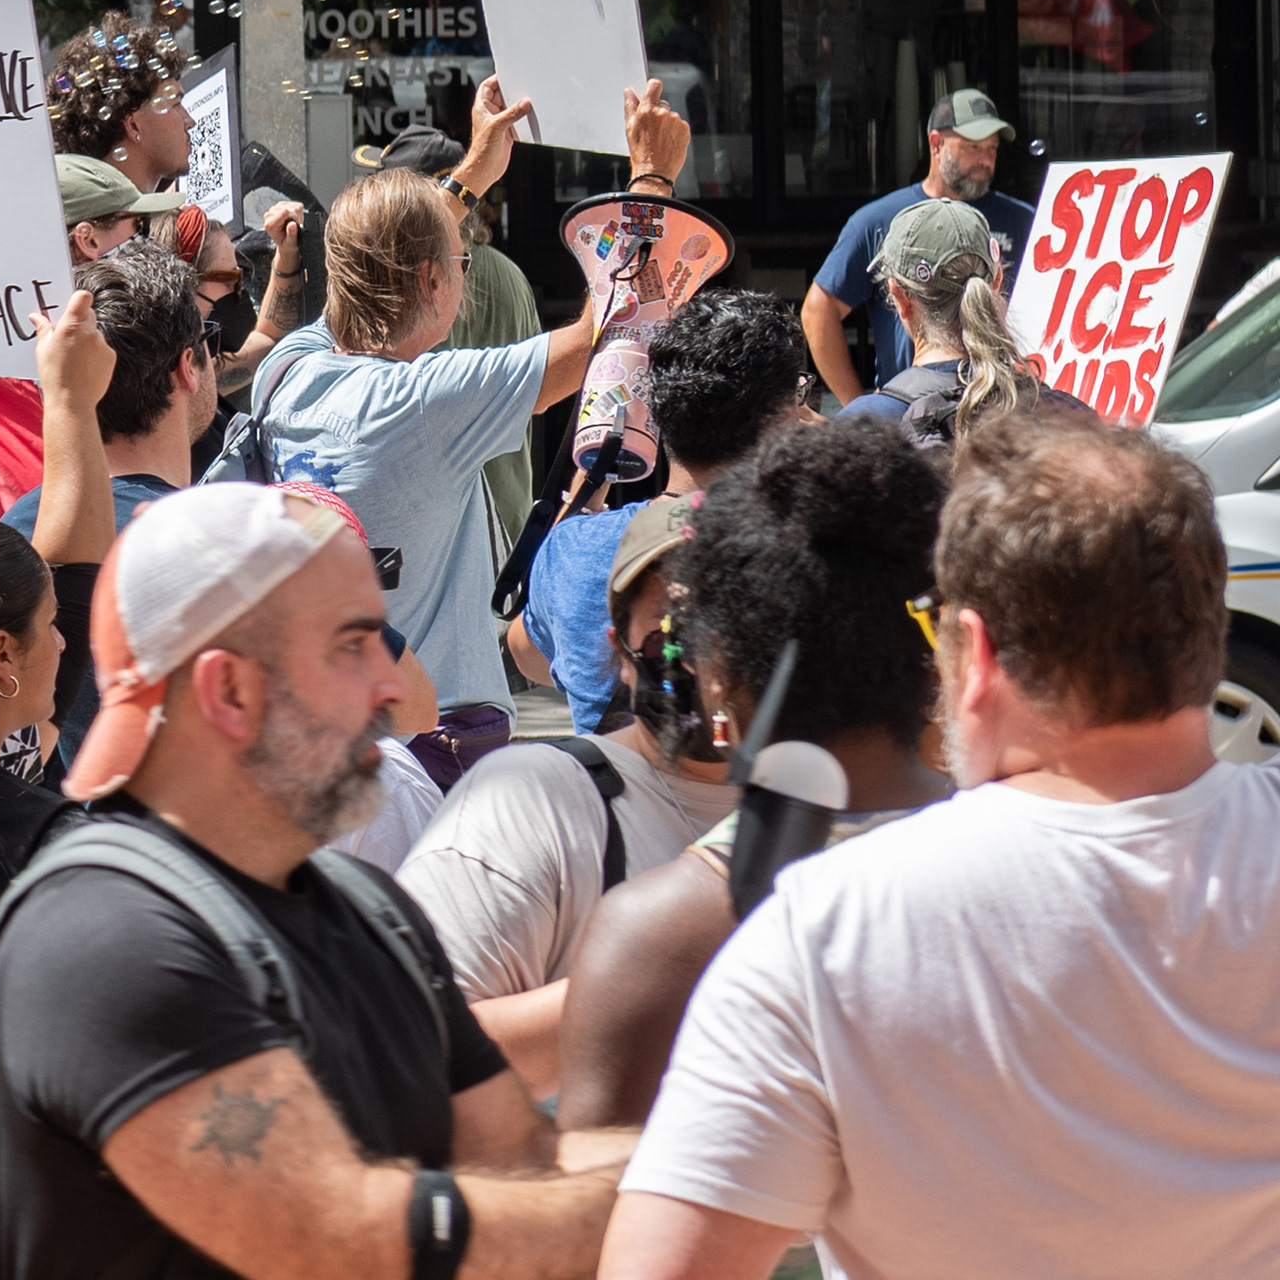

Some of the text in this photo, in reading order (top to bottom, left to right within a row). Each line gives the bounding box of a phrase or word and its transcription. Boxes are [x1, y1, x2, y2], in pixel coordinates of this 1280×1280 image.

[303, 7, 478, 40] MOOTHIES
[304, 57, 472, 88] REAKFAST
[357, 105, 433, 136] NCH
[1033, 166, 1214, 273] STOP
[1014, 343, 1164, 429] AIDS
